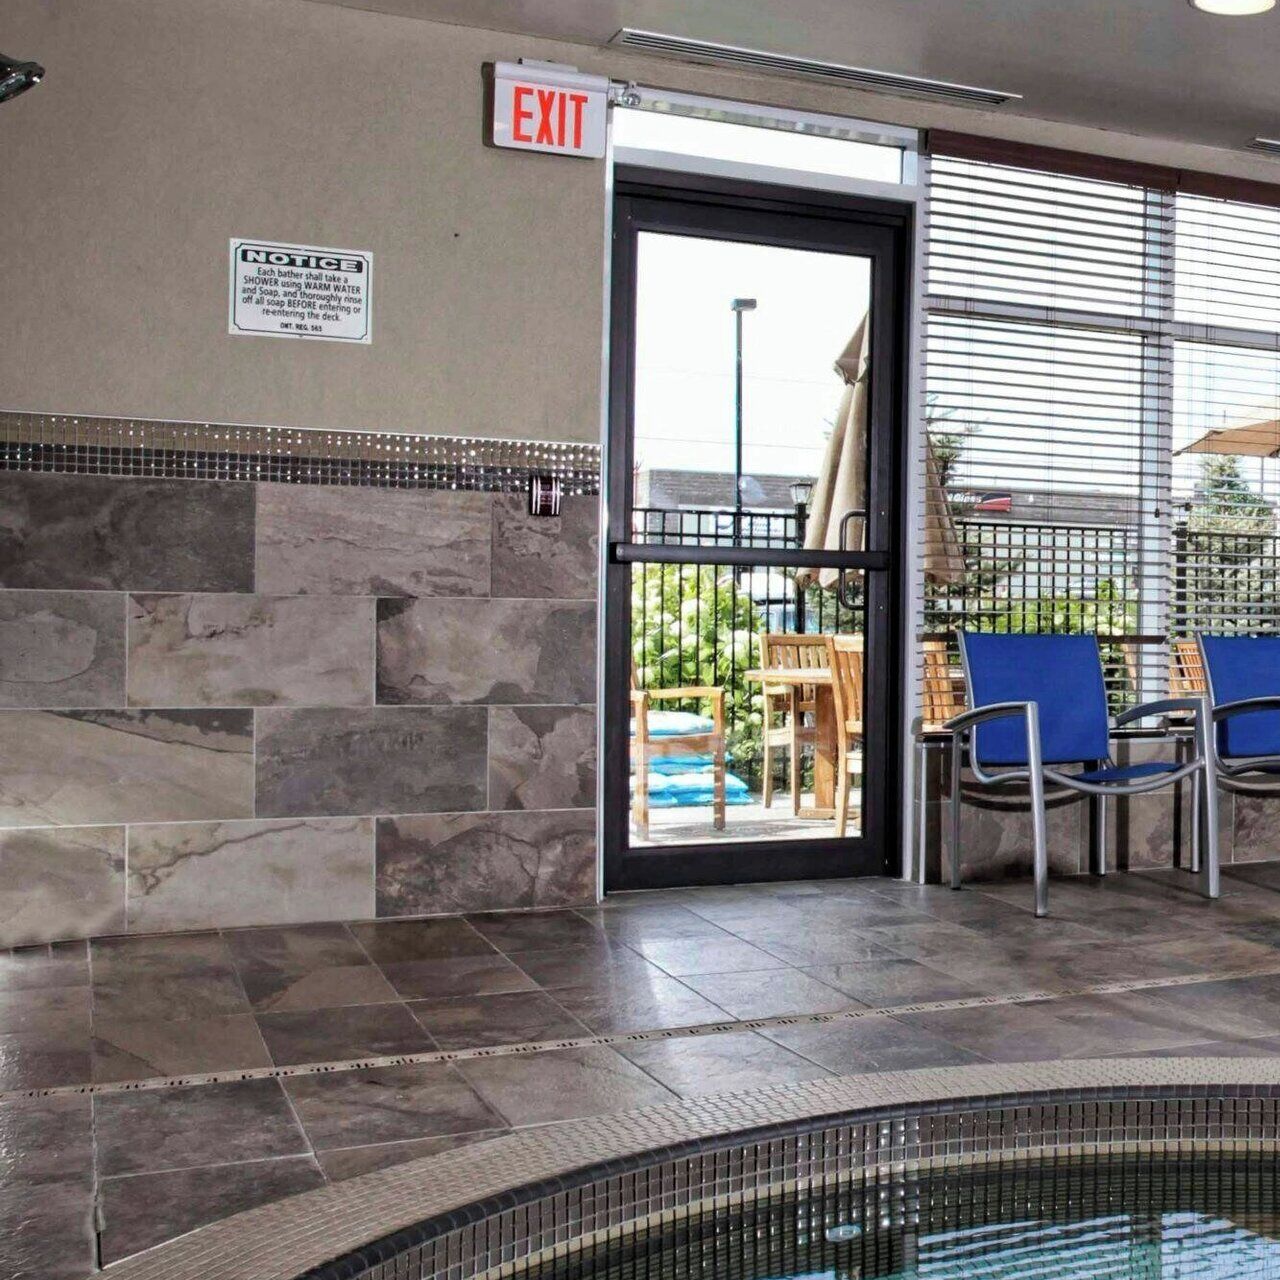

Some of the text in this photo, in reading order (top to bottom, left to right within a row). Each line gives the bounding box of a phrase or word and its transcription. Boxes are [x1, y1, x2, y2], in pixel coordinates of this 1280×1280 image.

[513, 86, 588, 149] EXIT
[246, 250, 358, 272] NOTICE
[243, 275, 361, 294] SHOWER using WARM WATER
[257, 267, 275, 276] Each
[278, 269, 303, 279] bather
[306, 272, 322, 281] shall
[325, 274, 341, 283] take
[242, 286, 256, 294] and
[283, 290, 297, 298] and
[300, 290, 342, 304] thoroughly
[344, 294, 362, 305] rinse
[242, 295, 253, 304] off
[255, 296, 264, 305] all
[267, 298, 285, 308] soap
[287, 299, 317, 309] BEFORE
[319, 303, 351, 315] entering
[262, 308, 305, 320] re-entering
[307, 311, 320, 319] the
